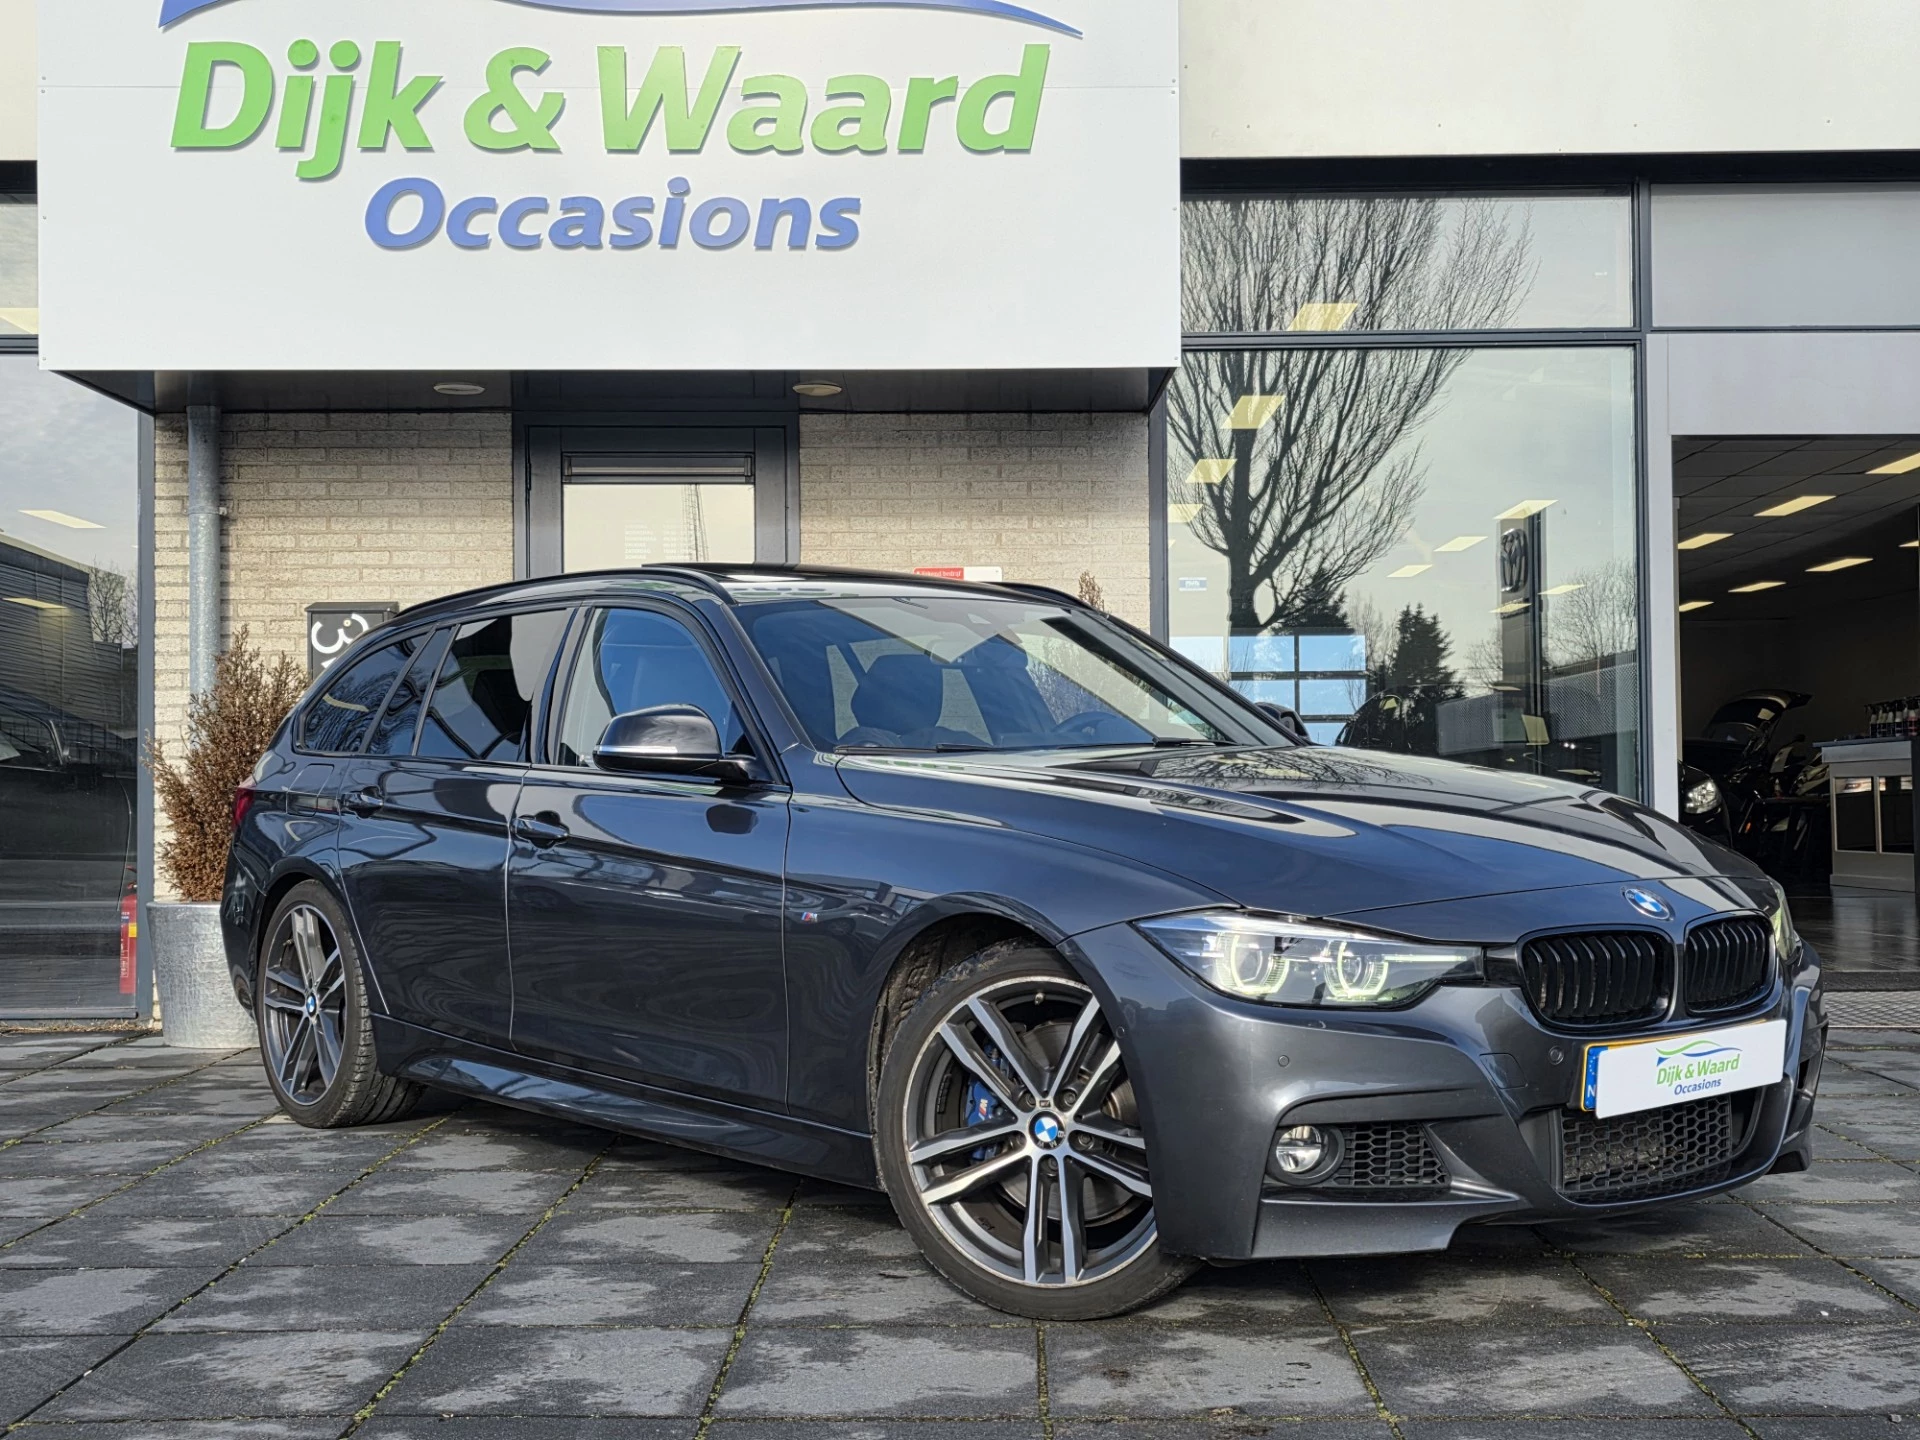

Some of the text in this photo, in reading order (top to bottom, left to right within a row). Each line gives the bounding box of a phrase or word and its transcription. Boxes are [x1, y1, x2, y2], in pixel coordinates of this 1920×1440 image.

[171, 39, 1050, 179] Dijk & Waard
[365, 176, 861, 249] Occasions
[1657, 1054, 1740, 1086] Dijk & Waard
[1674, 1078, 1722, 1095] Occasions
